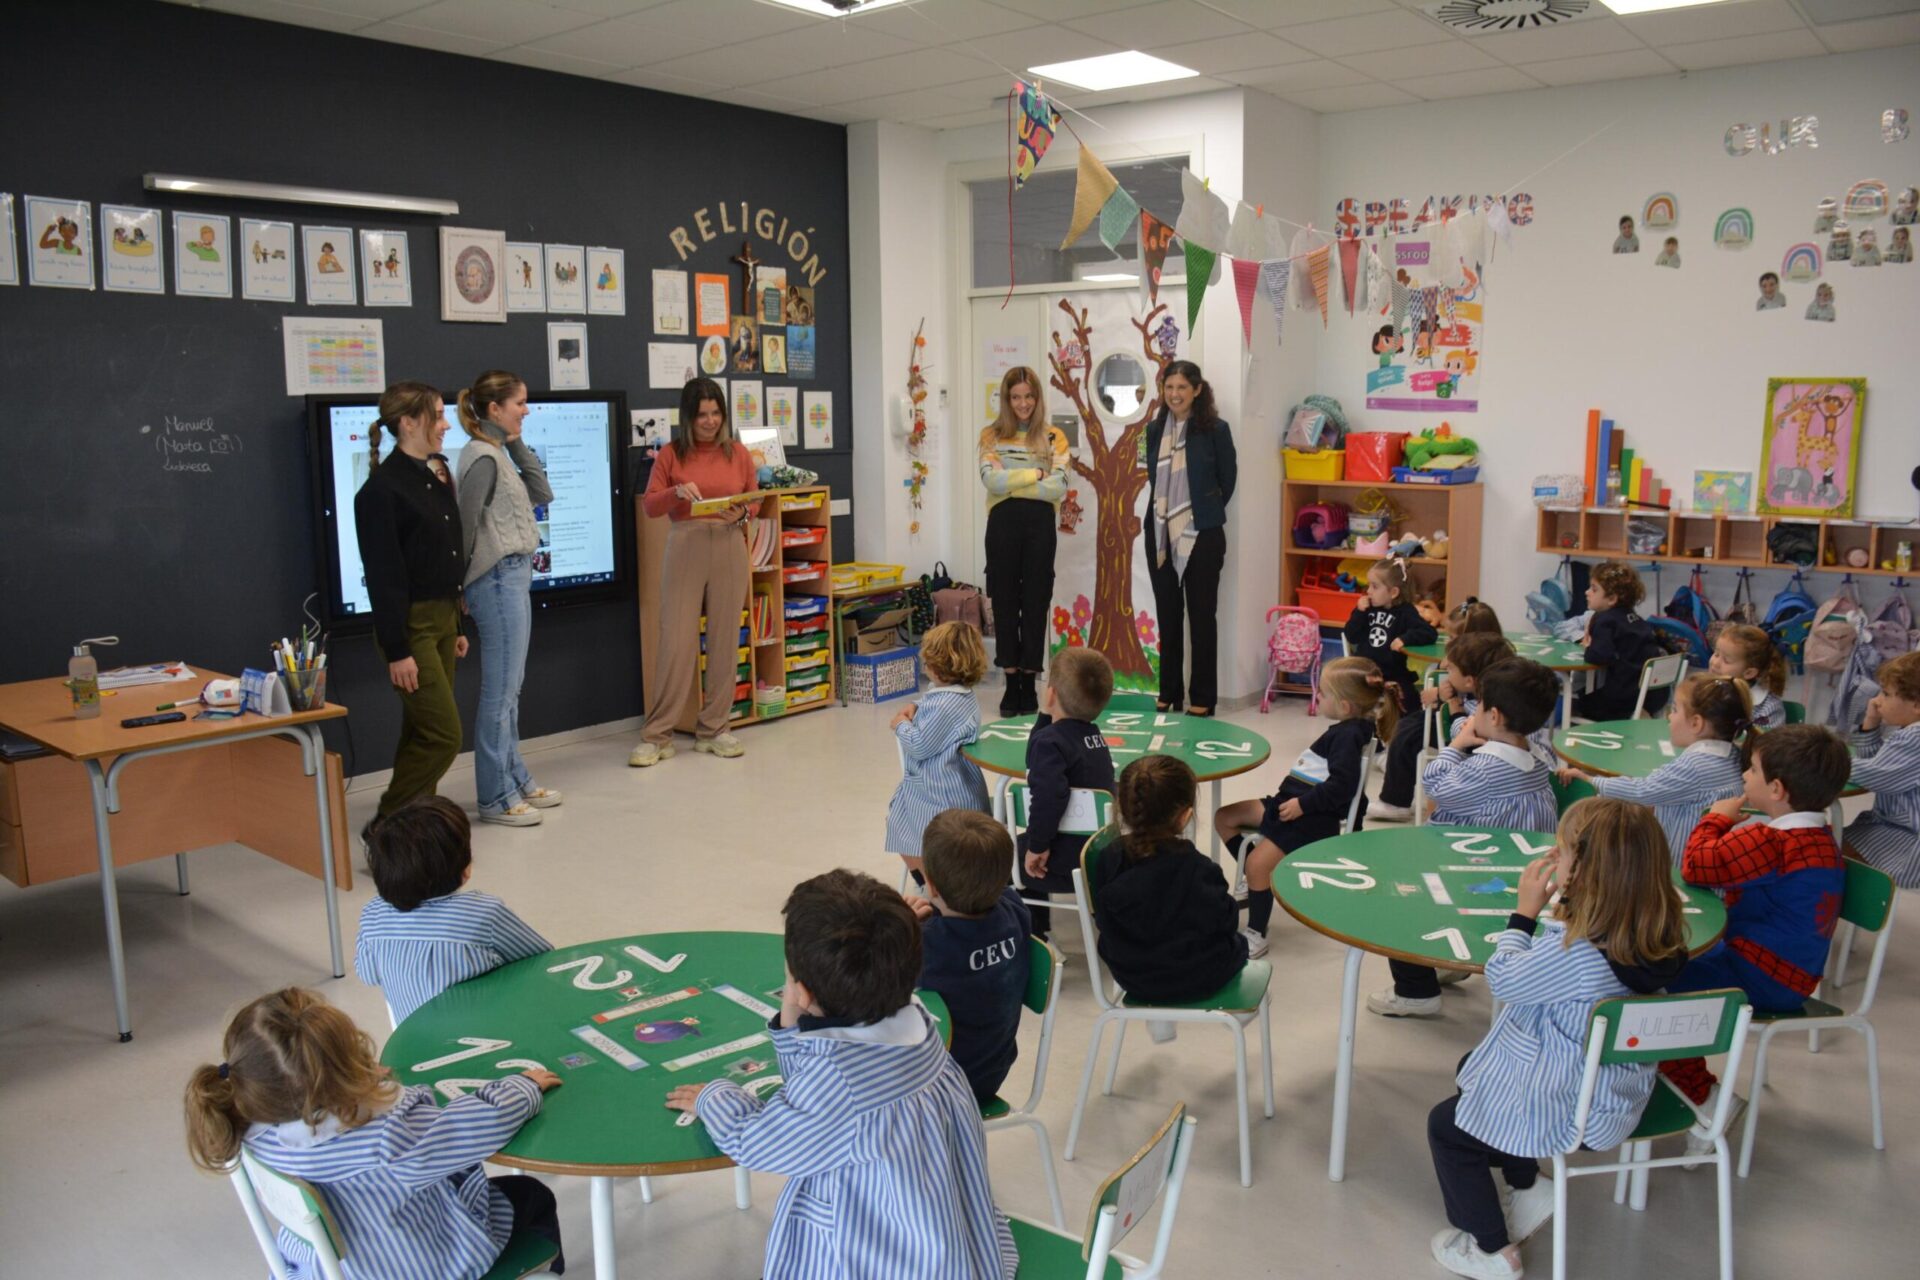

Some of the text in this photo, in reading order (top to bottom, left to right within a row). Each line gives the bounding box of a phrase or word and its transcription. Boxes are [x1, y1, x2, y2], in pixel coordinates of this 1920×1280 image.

[1724, 115, 1820, 157] OUR
[669, 201, 827, 287] RELIGIÓN
[165, 415, 215, 435] Manuel
[1368, 611, 1396, 628] CEU
[969, 937, 1016, 971] CEU
